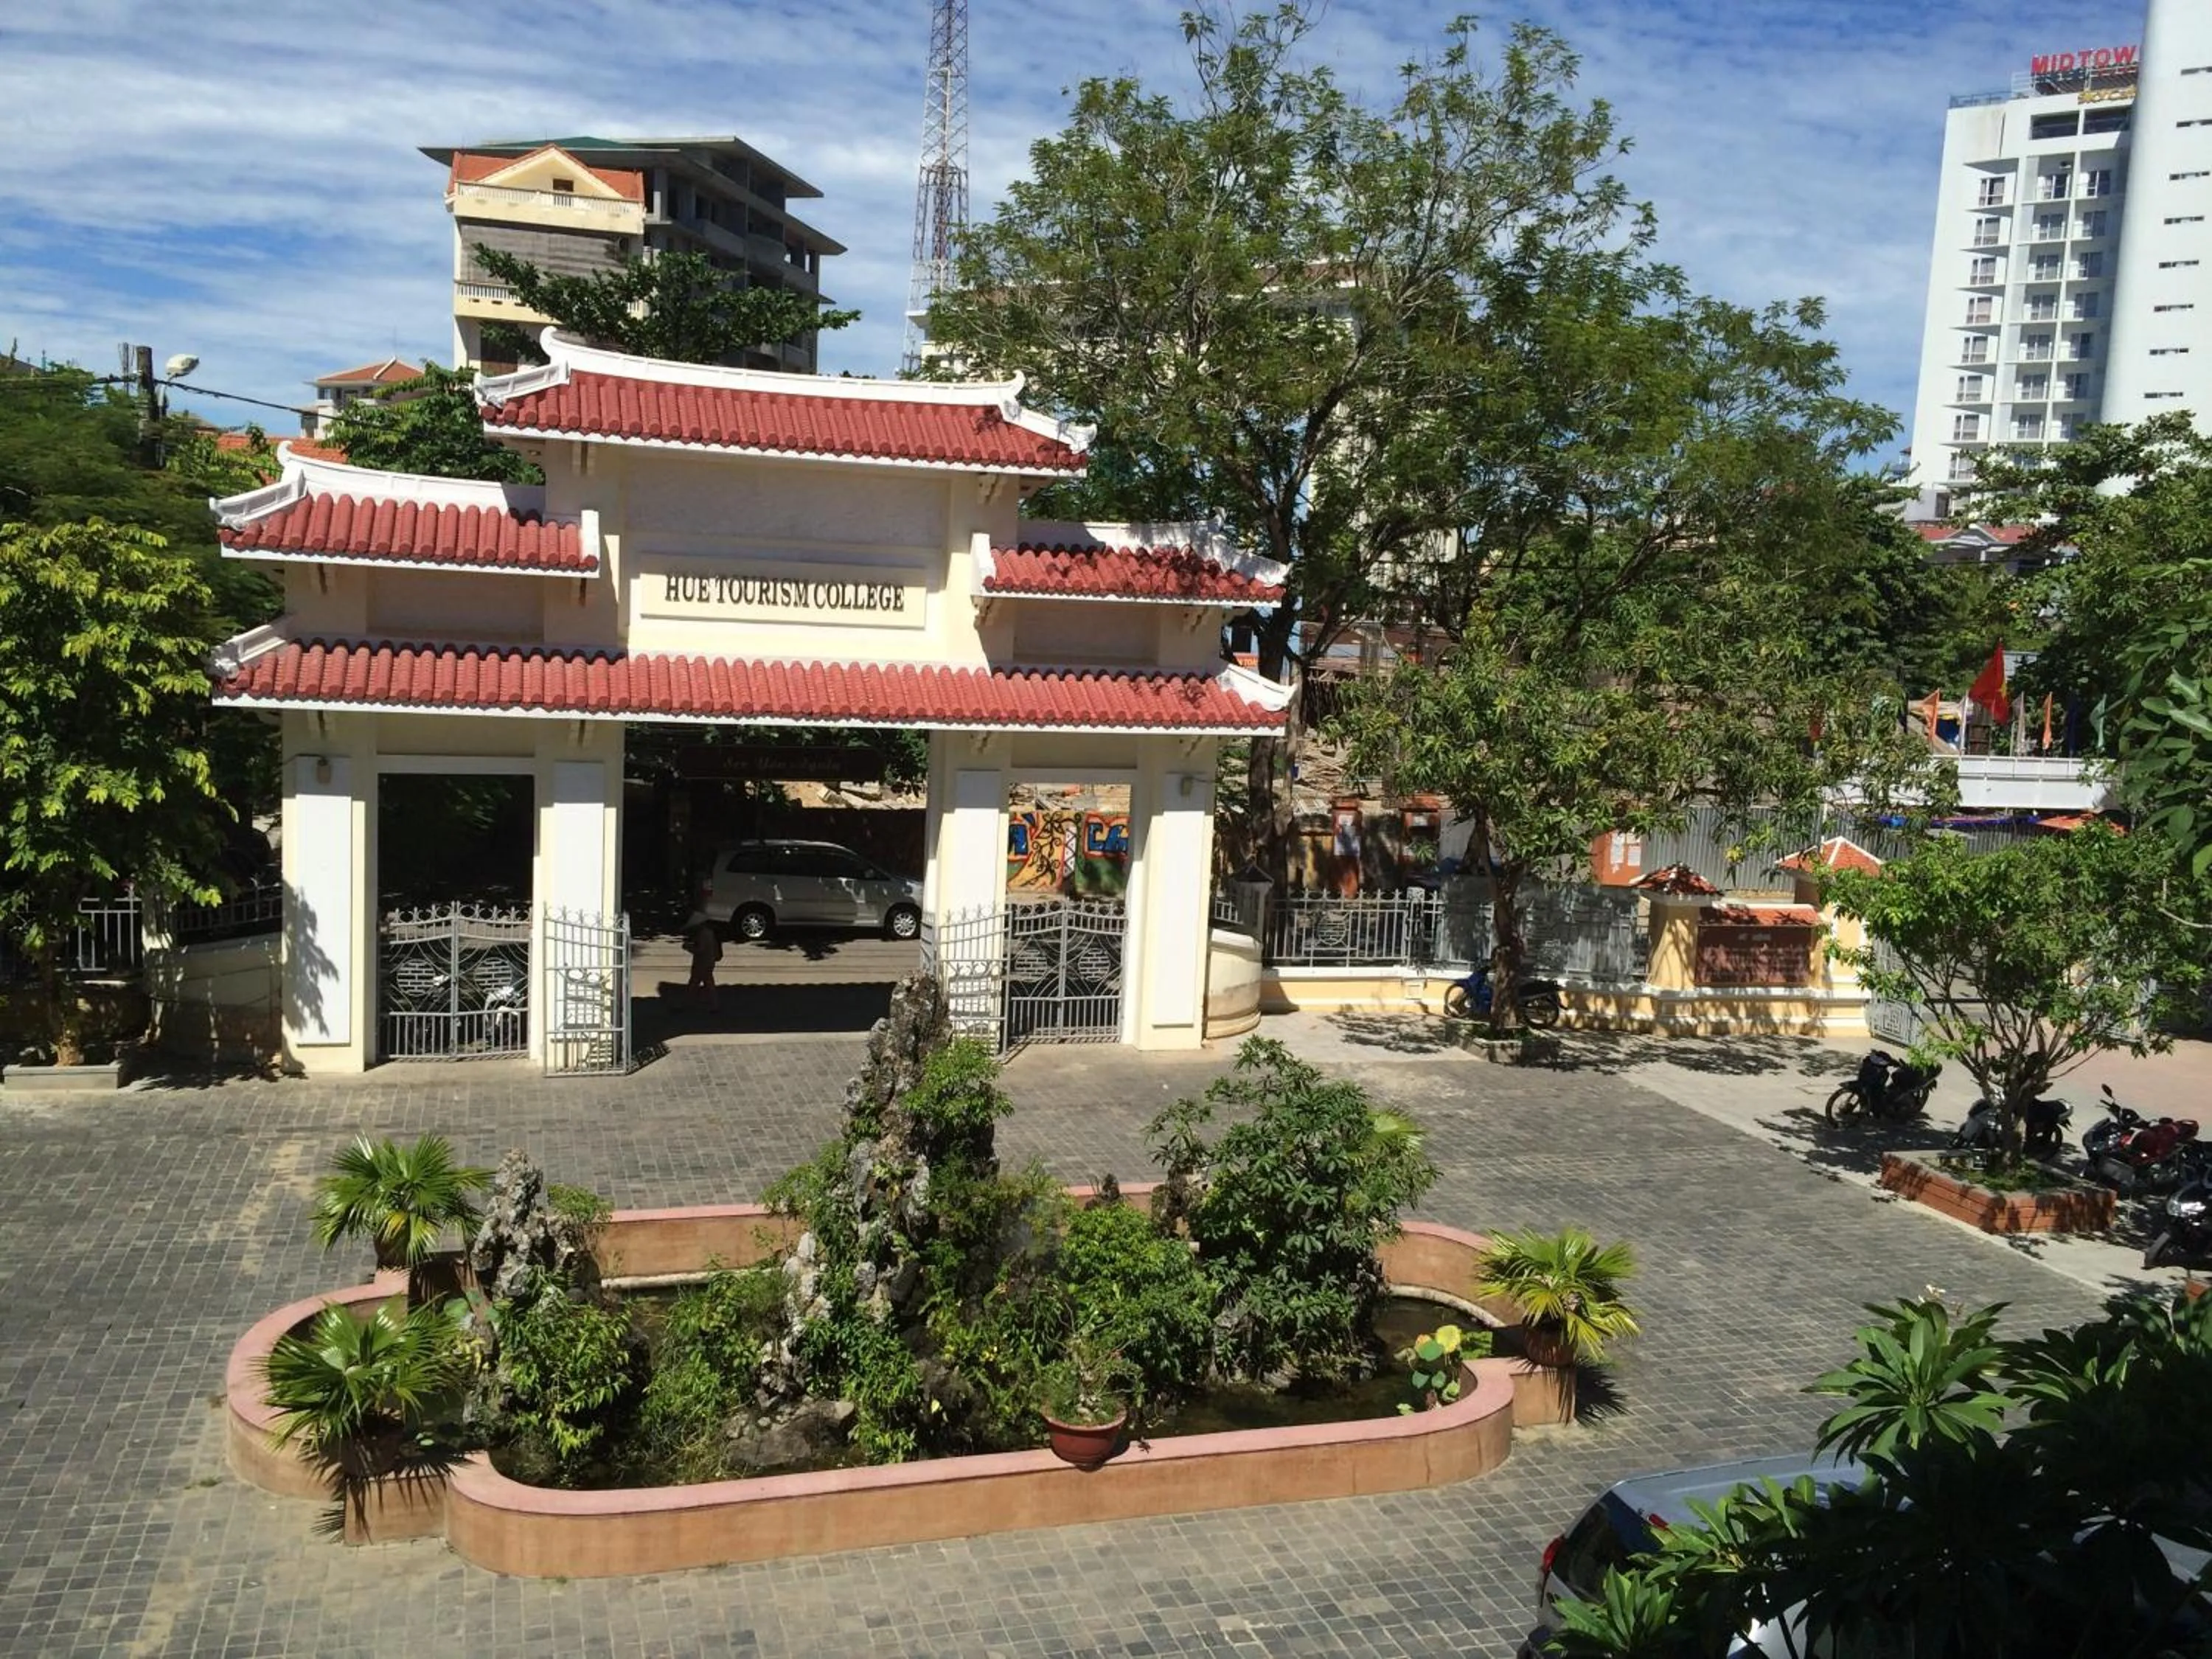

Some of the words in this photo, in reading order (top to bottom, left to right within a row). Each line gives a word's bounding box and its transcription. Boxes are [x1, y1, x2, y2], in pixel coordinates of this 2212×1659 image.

[665, 575, 710, 602] HUE
[714, 577, 810, 608] TOURISM
[813, 582, 905, 612] COLLEGE
